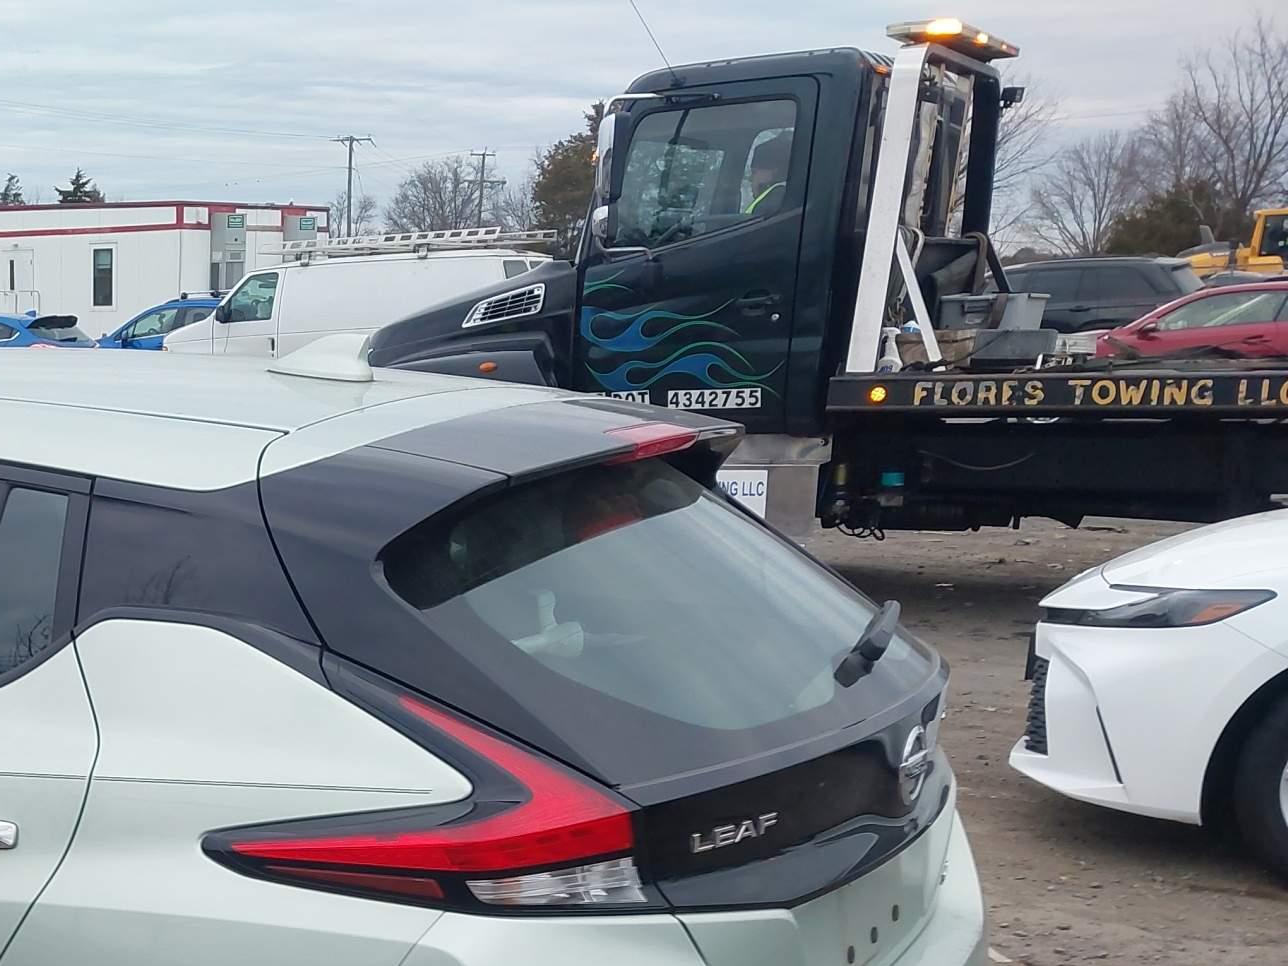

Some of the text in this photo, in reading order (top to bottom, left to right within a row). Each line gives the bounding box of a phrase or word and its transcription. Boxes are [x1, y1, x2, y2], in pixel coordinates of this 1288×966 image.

[669, 390, 759, 408] 4342755
[1068, 379, 1214, 406] TOWING
[742, 481, 765, 497] LLC
[691, 812, 779, 853] LEAF
